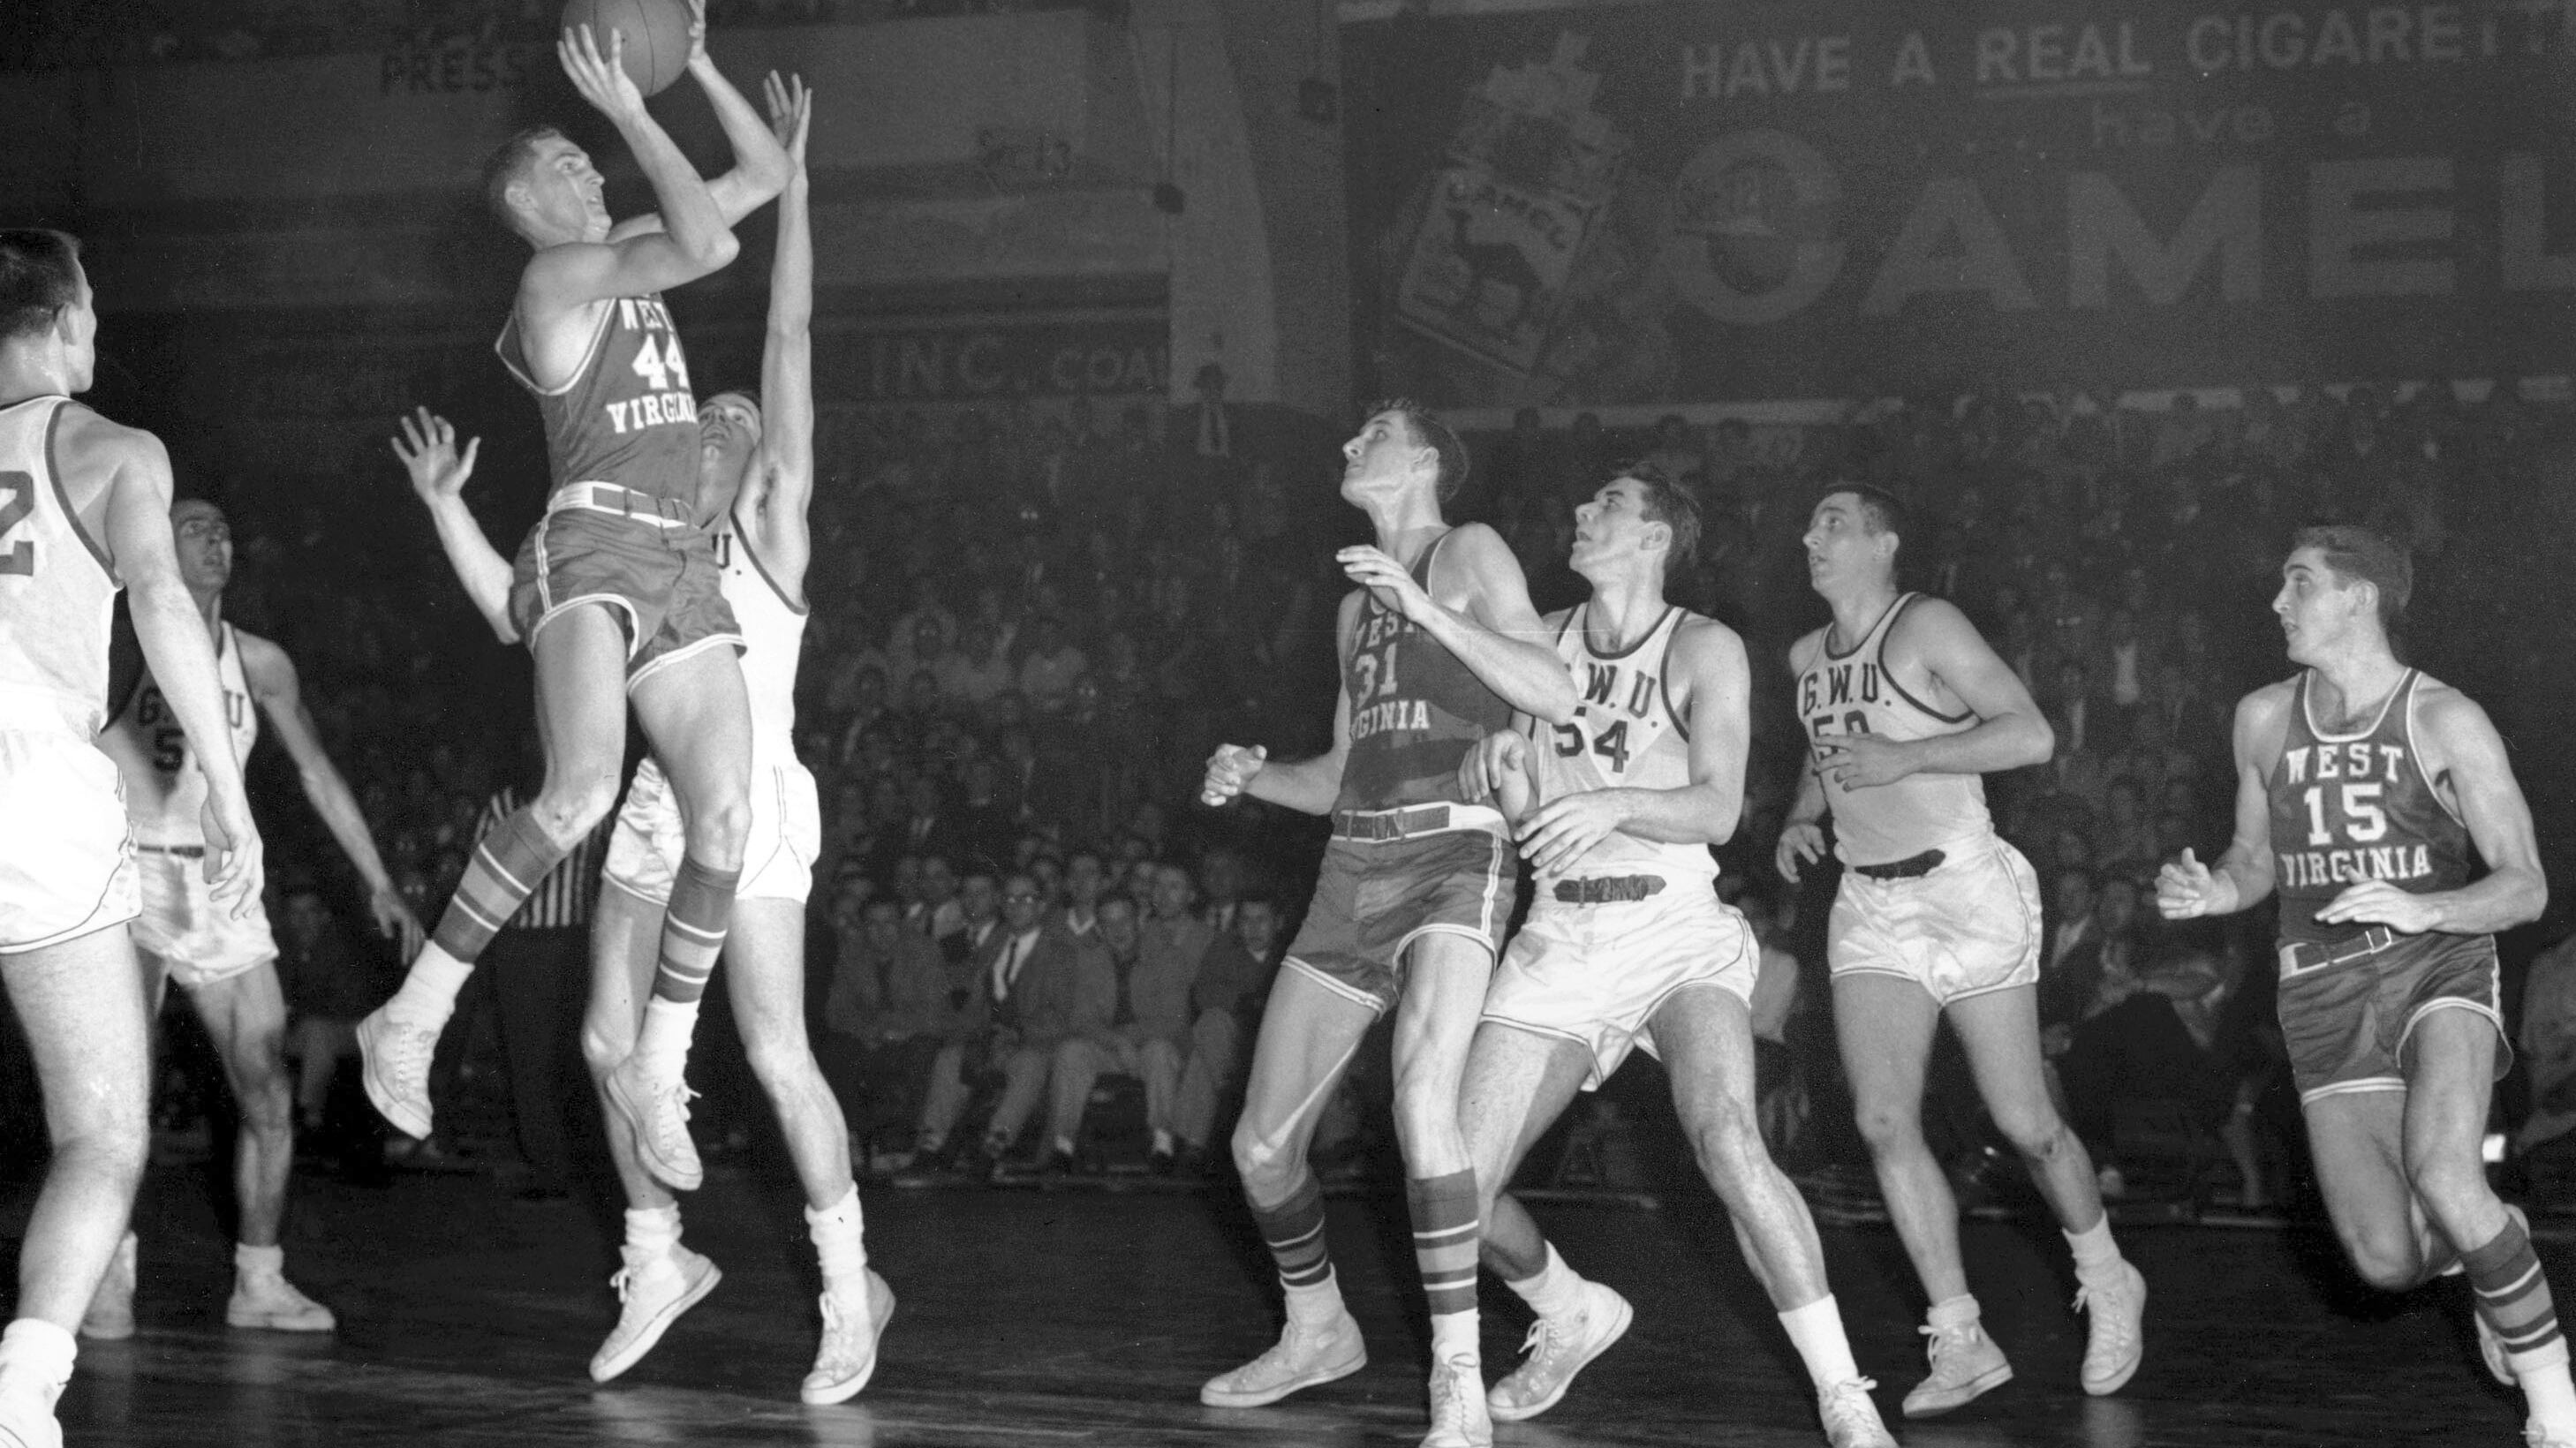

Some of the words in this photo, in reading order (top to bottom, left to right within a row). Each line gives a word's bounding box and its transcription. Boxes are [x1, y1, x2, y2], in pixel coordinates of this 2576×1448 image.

[381, 48, 529, 95] PRESS
[1680, 34, 1852, 101] HAVE
[1892, 32, 1938, 87] A
[1974, 20, 2154, 85] REAL
[2090, 100, 2276, 148] have
[2332, 101, 2372, 136] a
[1670, 126, 2576, 326] CAMEL
[632, 333, 690, 389] 44
[870, 334, 1029, 396] INC.
[1803, 662, 1892, 717] G.W.U.
[2285, 743, 2404, 785] WEST
[2303, 782, 2388, 847] 15
[2280, 844, 2433, 887] VIRGINIA
